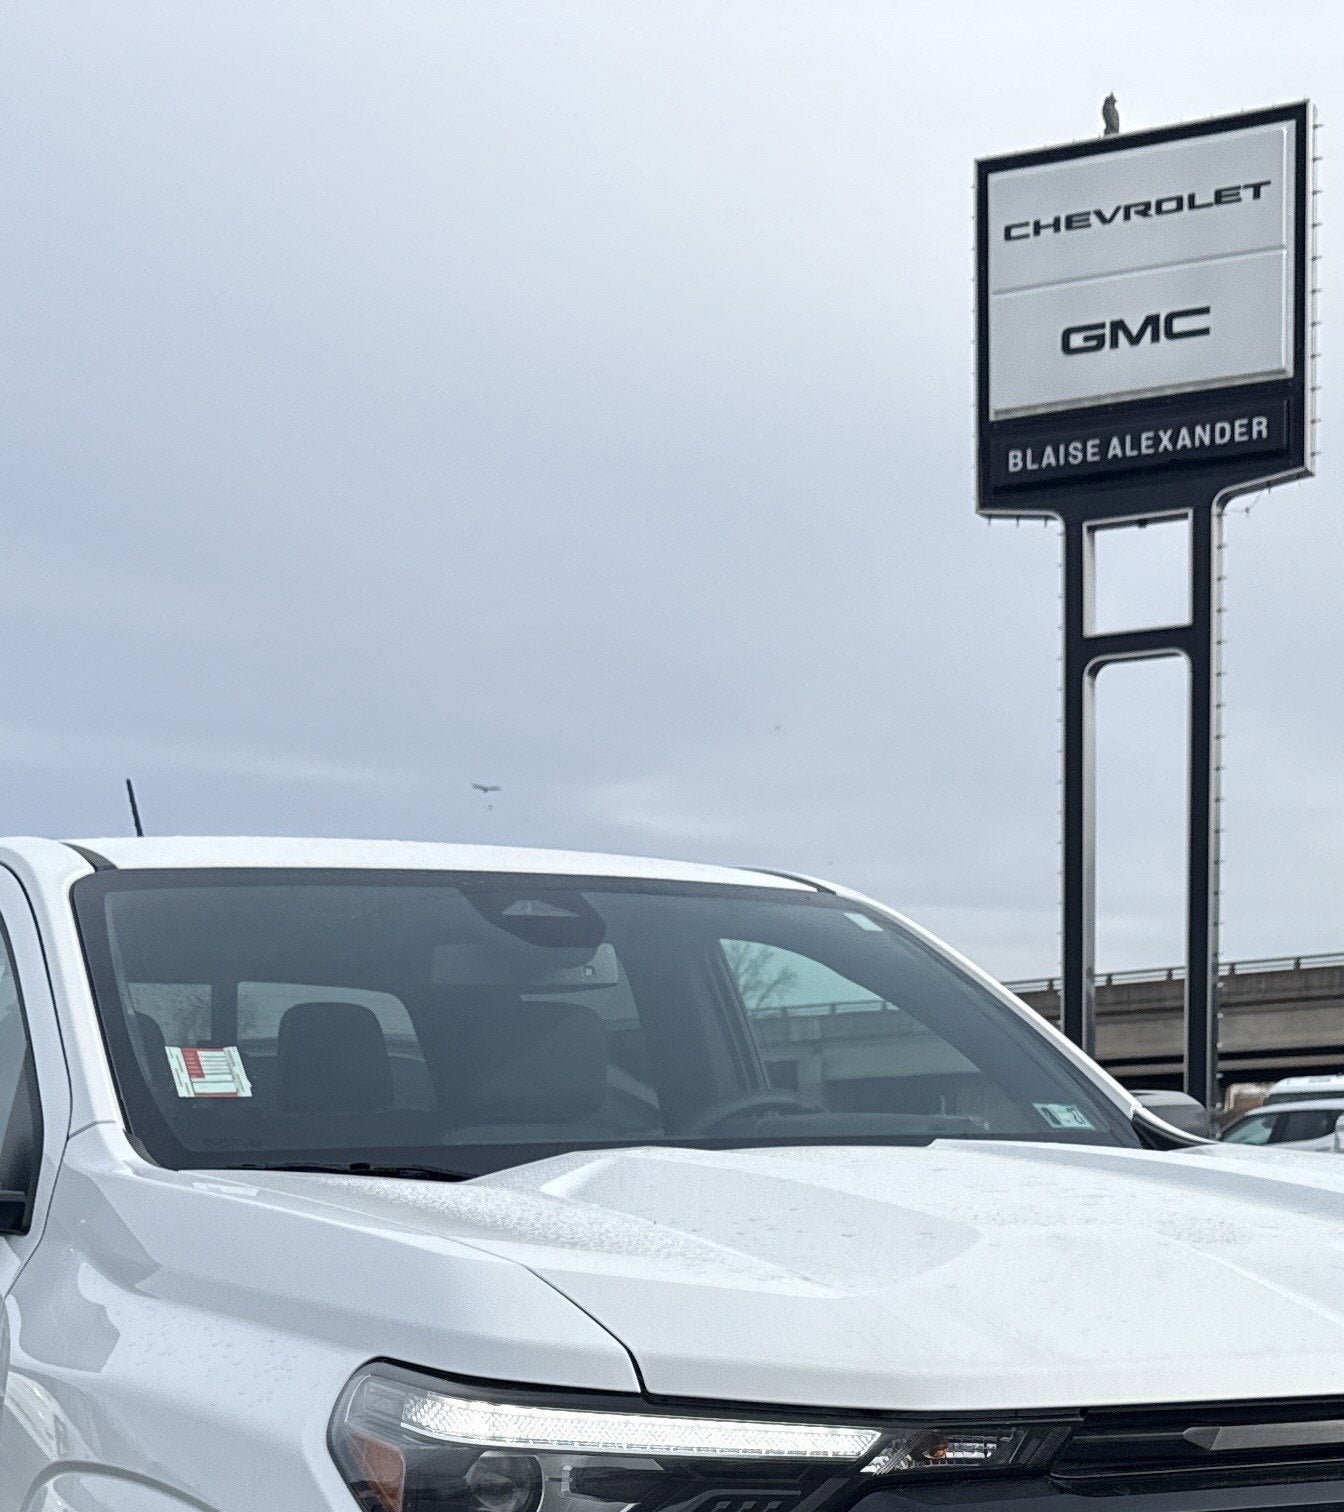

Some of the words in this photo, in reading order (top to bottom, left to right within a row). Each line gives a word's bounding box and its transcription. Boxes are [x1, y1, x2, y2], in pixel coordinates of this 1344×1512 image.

[1004, 181, 1272, 241] CHEVROLET
[1061, 306, 1211, 356] GMC
[1008, 438, 1101, 473] BLAISE
[1106, 416, 1269, 460] ALEXANDER
